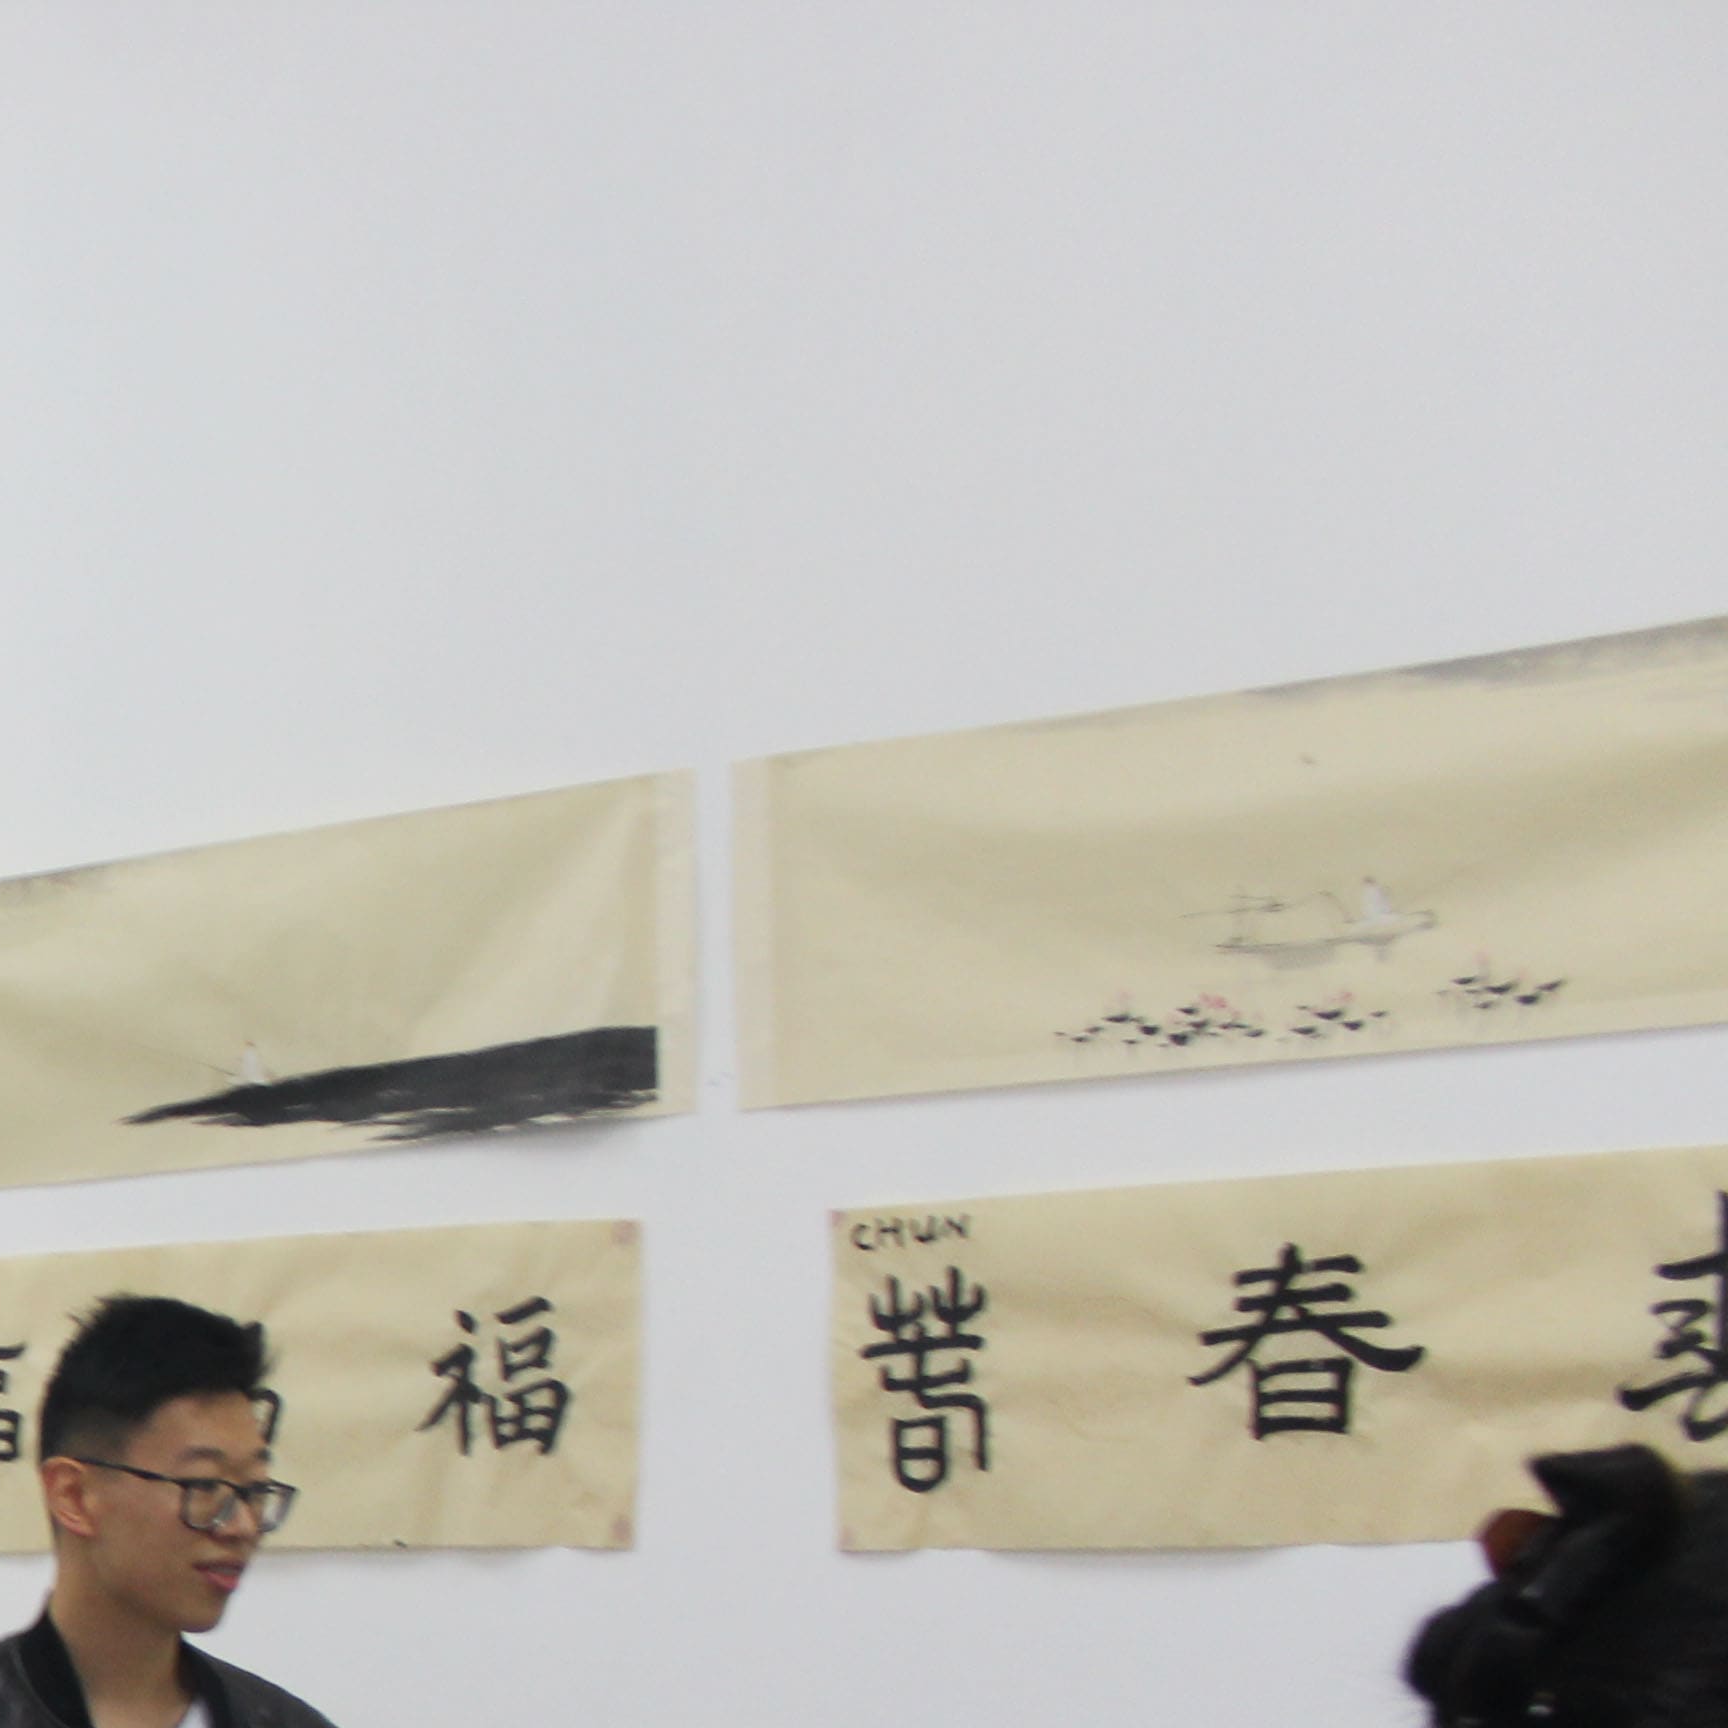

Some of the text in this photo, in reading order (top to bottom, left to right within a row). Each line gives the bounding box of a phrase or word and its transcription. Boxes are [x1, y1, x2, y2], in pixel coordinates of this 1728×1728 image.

[850, 1216, 971, 1253] CHUN
[415, 1295, 573, 1457] 福
[1187, 1241, 1426, 1442] 春
